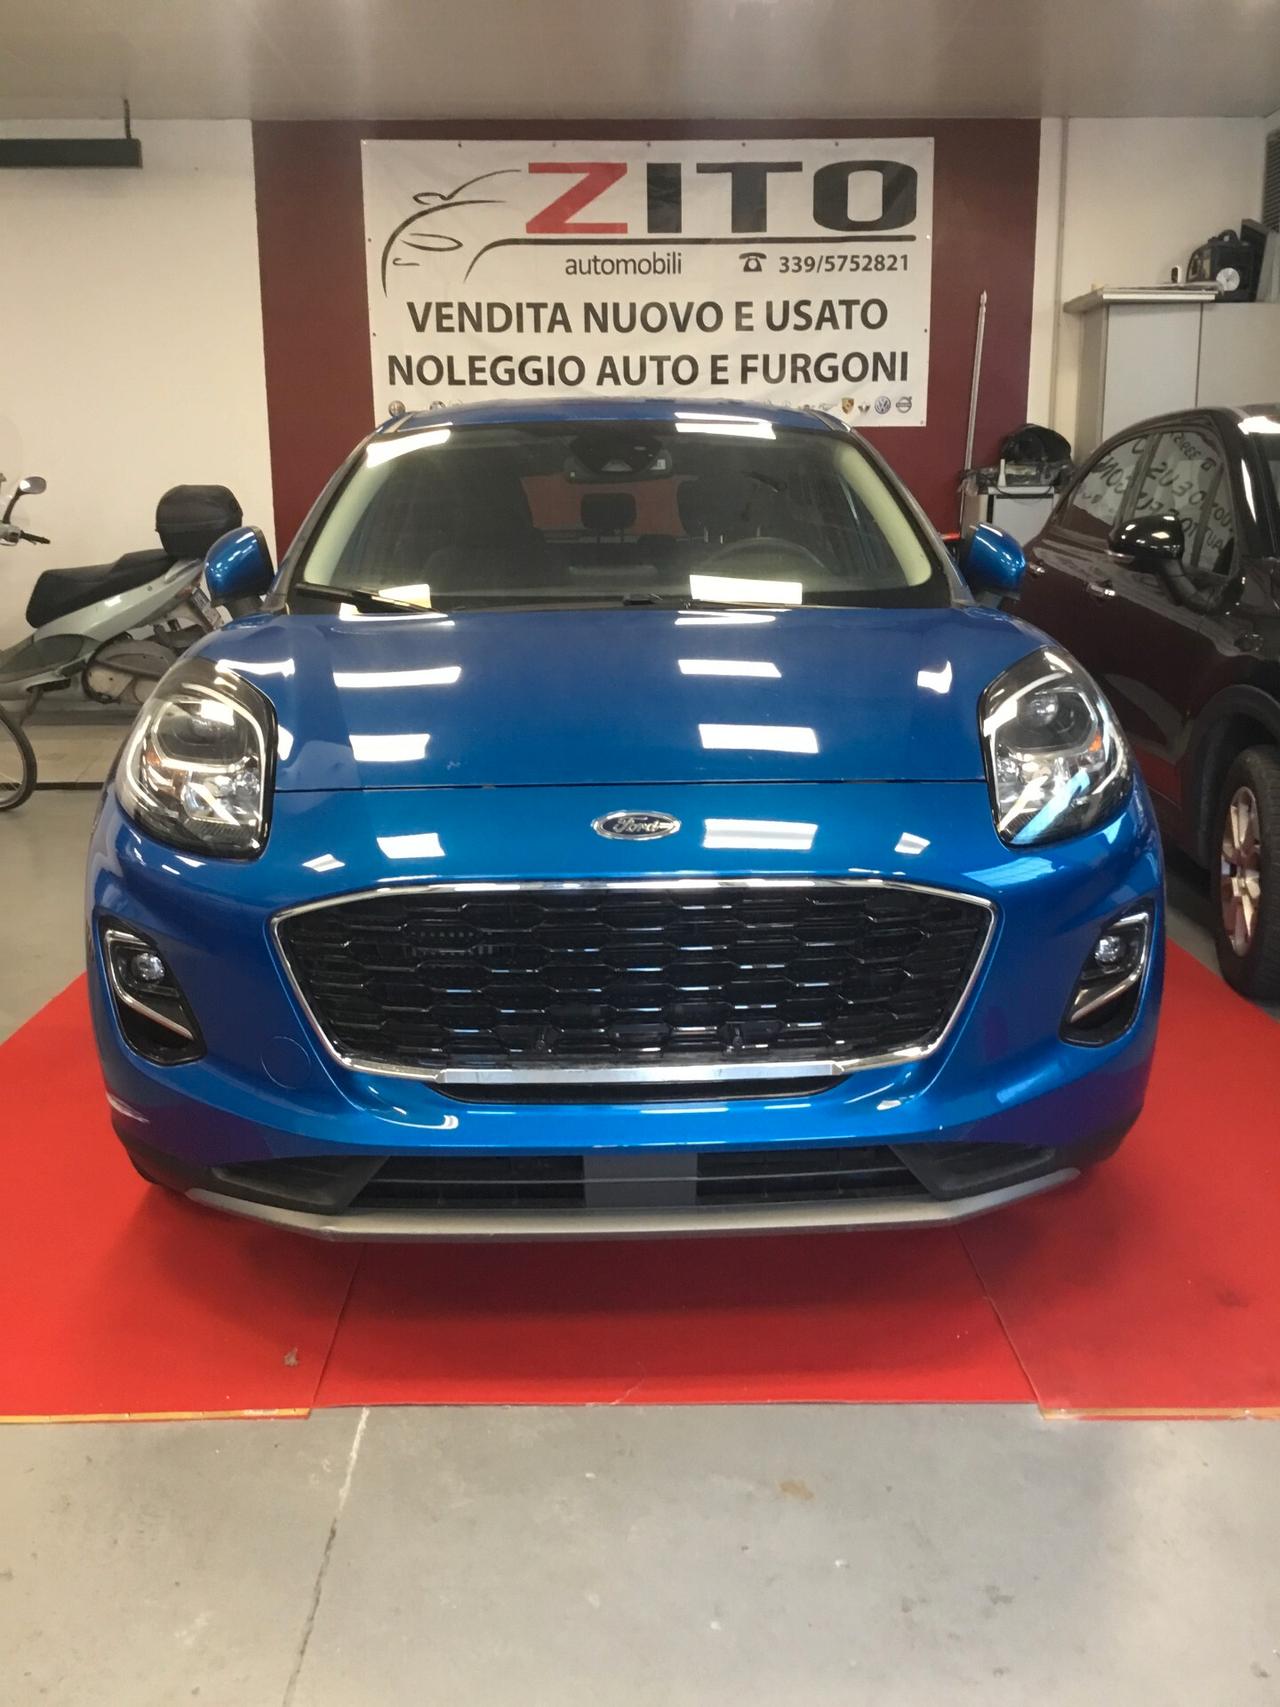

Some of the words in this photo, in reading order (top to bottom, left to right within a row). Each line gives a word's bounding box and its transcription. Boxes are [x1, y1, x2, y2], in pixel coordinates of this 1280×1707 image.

[525, 160, 919, 234] ZITO
[565, 251, 682, 276] automobili
[779, 254, 909, 274] 339/5752821
[407, 301, 573, 334] VENDITA
[583, 301, 724, 334] NUOVO
[735, 301, 755, 332] E
[765, 298, 888, 332] USATO
[388, 354, 586, 387] NOLEGGIO
[596, 354, 699, 386] AUTO
[710, 354, 729, 385] E
[740, 351, 909, 385] FURGONI
[613, 816, 662, 833] Ford
